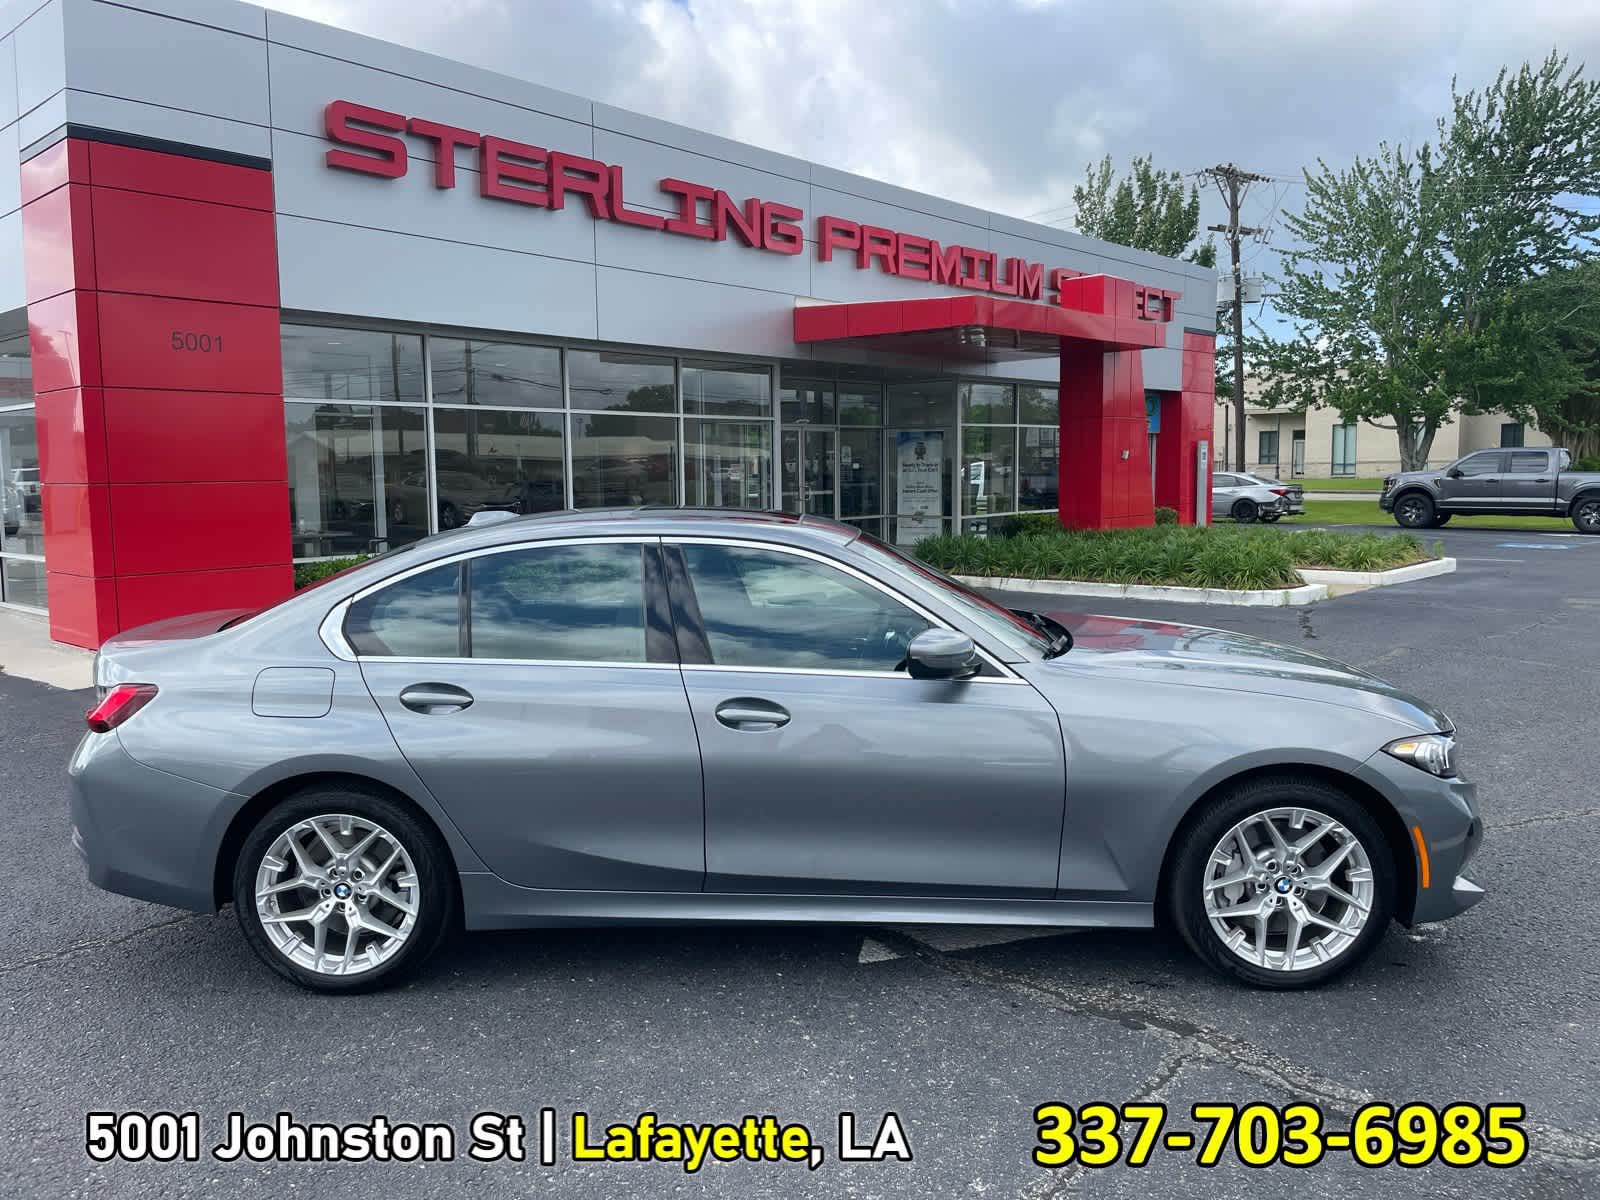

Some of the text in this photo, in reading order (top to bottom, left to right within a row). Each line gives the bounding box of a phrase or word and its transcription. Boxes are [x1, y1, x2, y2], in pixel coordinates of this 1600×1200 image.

[325, 100, 804, 256] STERLING
[818, 216, 1045, 300] PREMIUM
[171, 330, 223, 353] 5001
